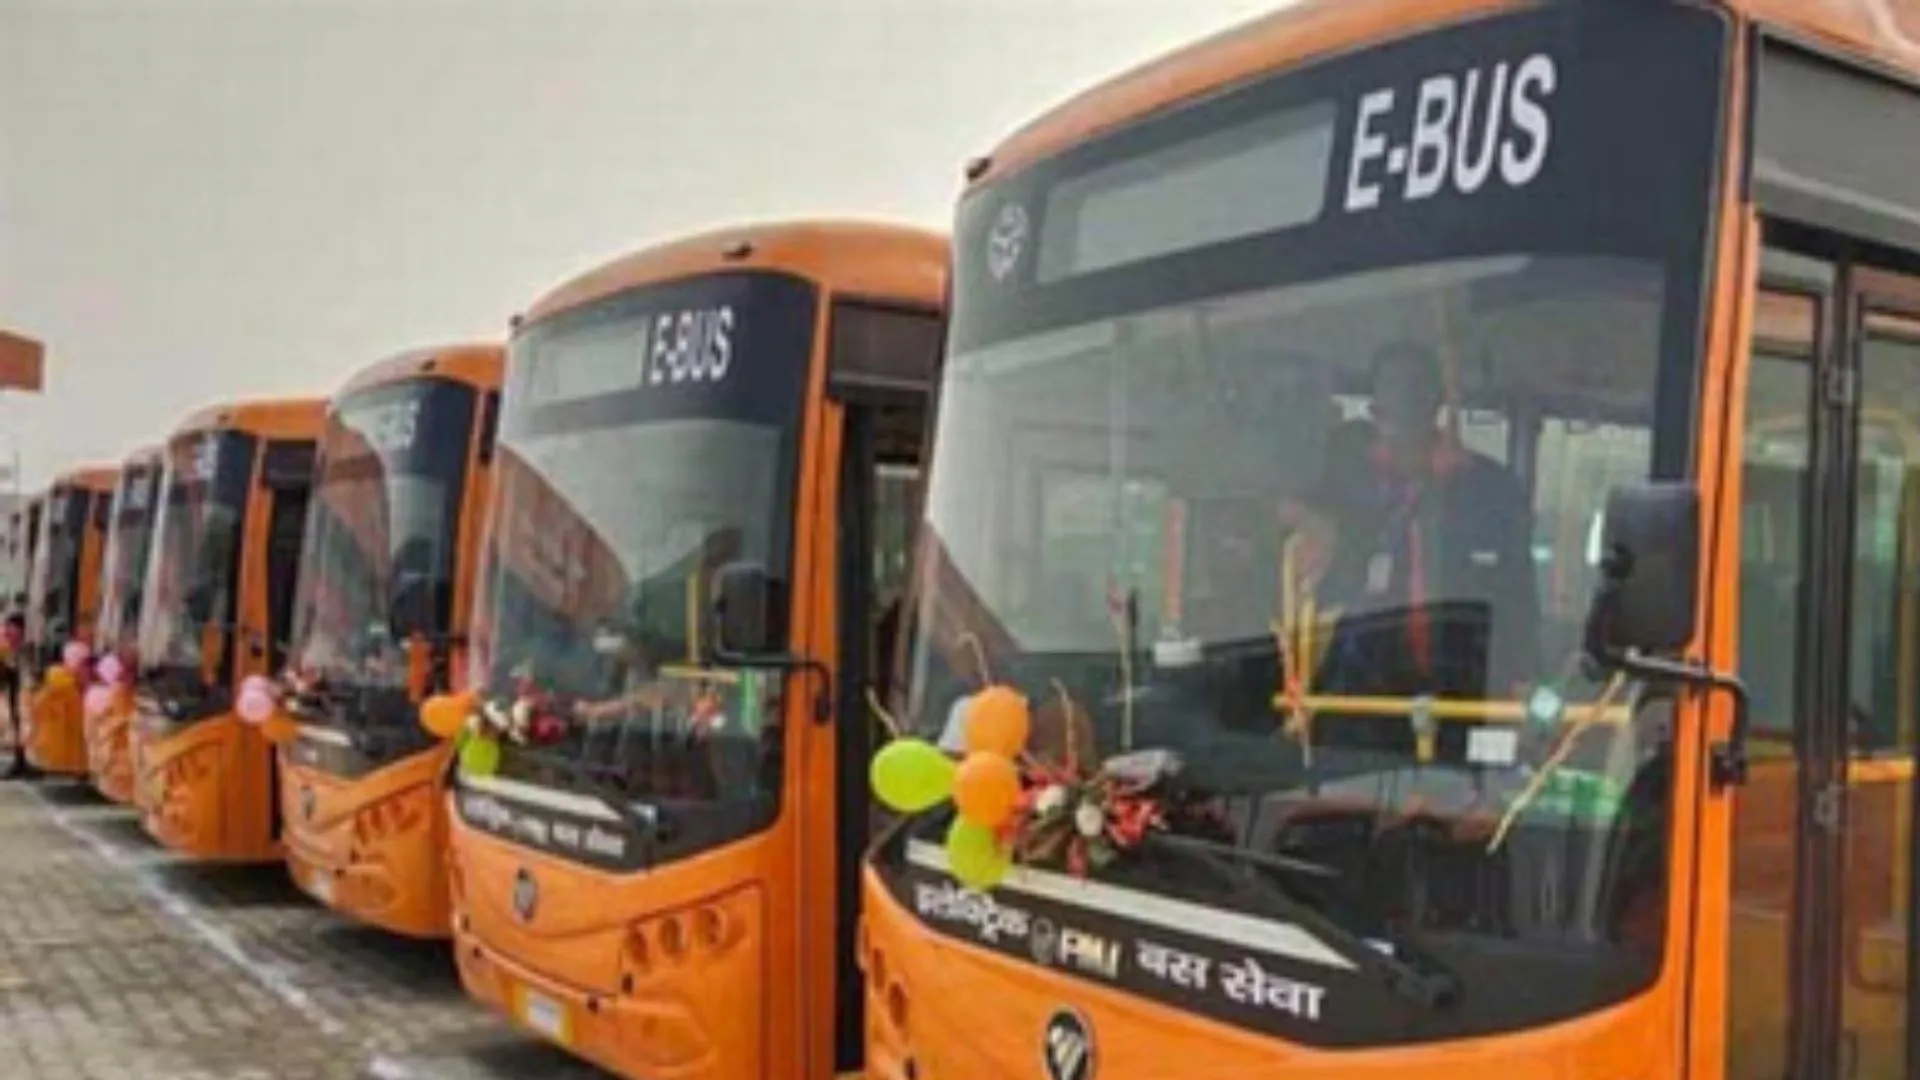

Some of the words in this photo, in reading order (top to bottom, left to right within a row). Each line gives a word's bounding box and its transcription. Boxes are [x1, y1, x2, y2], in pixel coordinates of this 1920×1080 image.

[1344, 53, 1557, 212] E-BUS
[651, 305, 734, 383] E-BUS
[1135, 938, 1211, 989] बस
[1220, 957, 1326, 1021] सेवा
